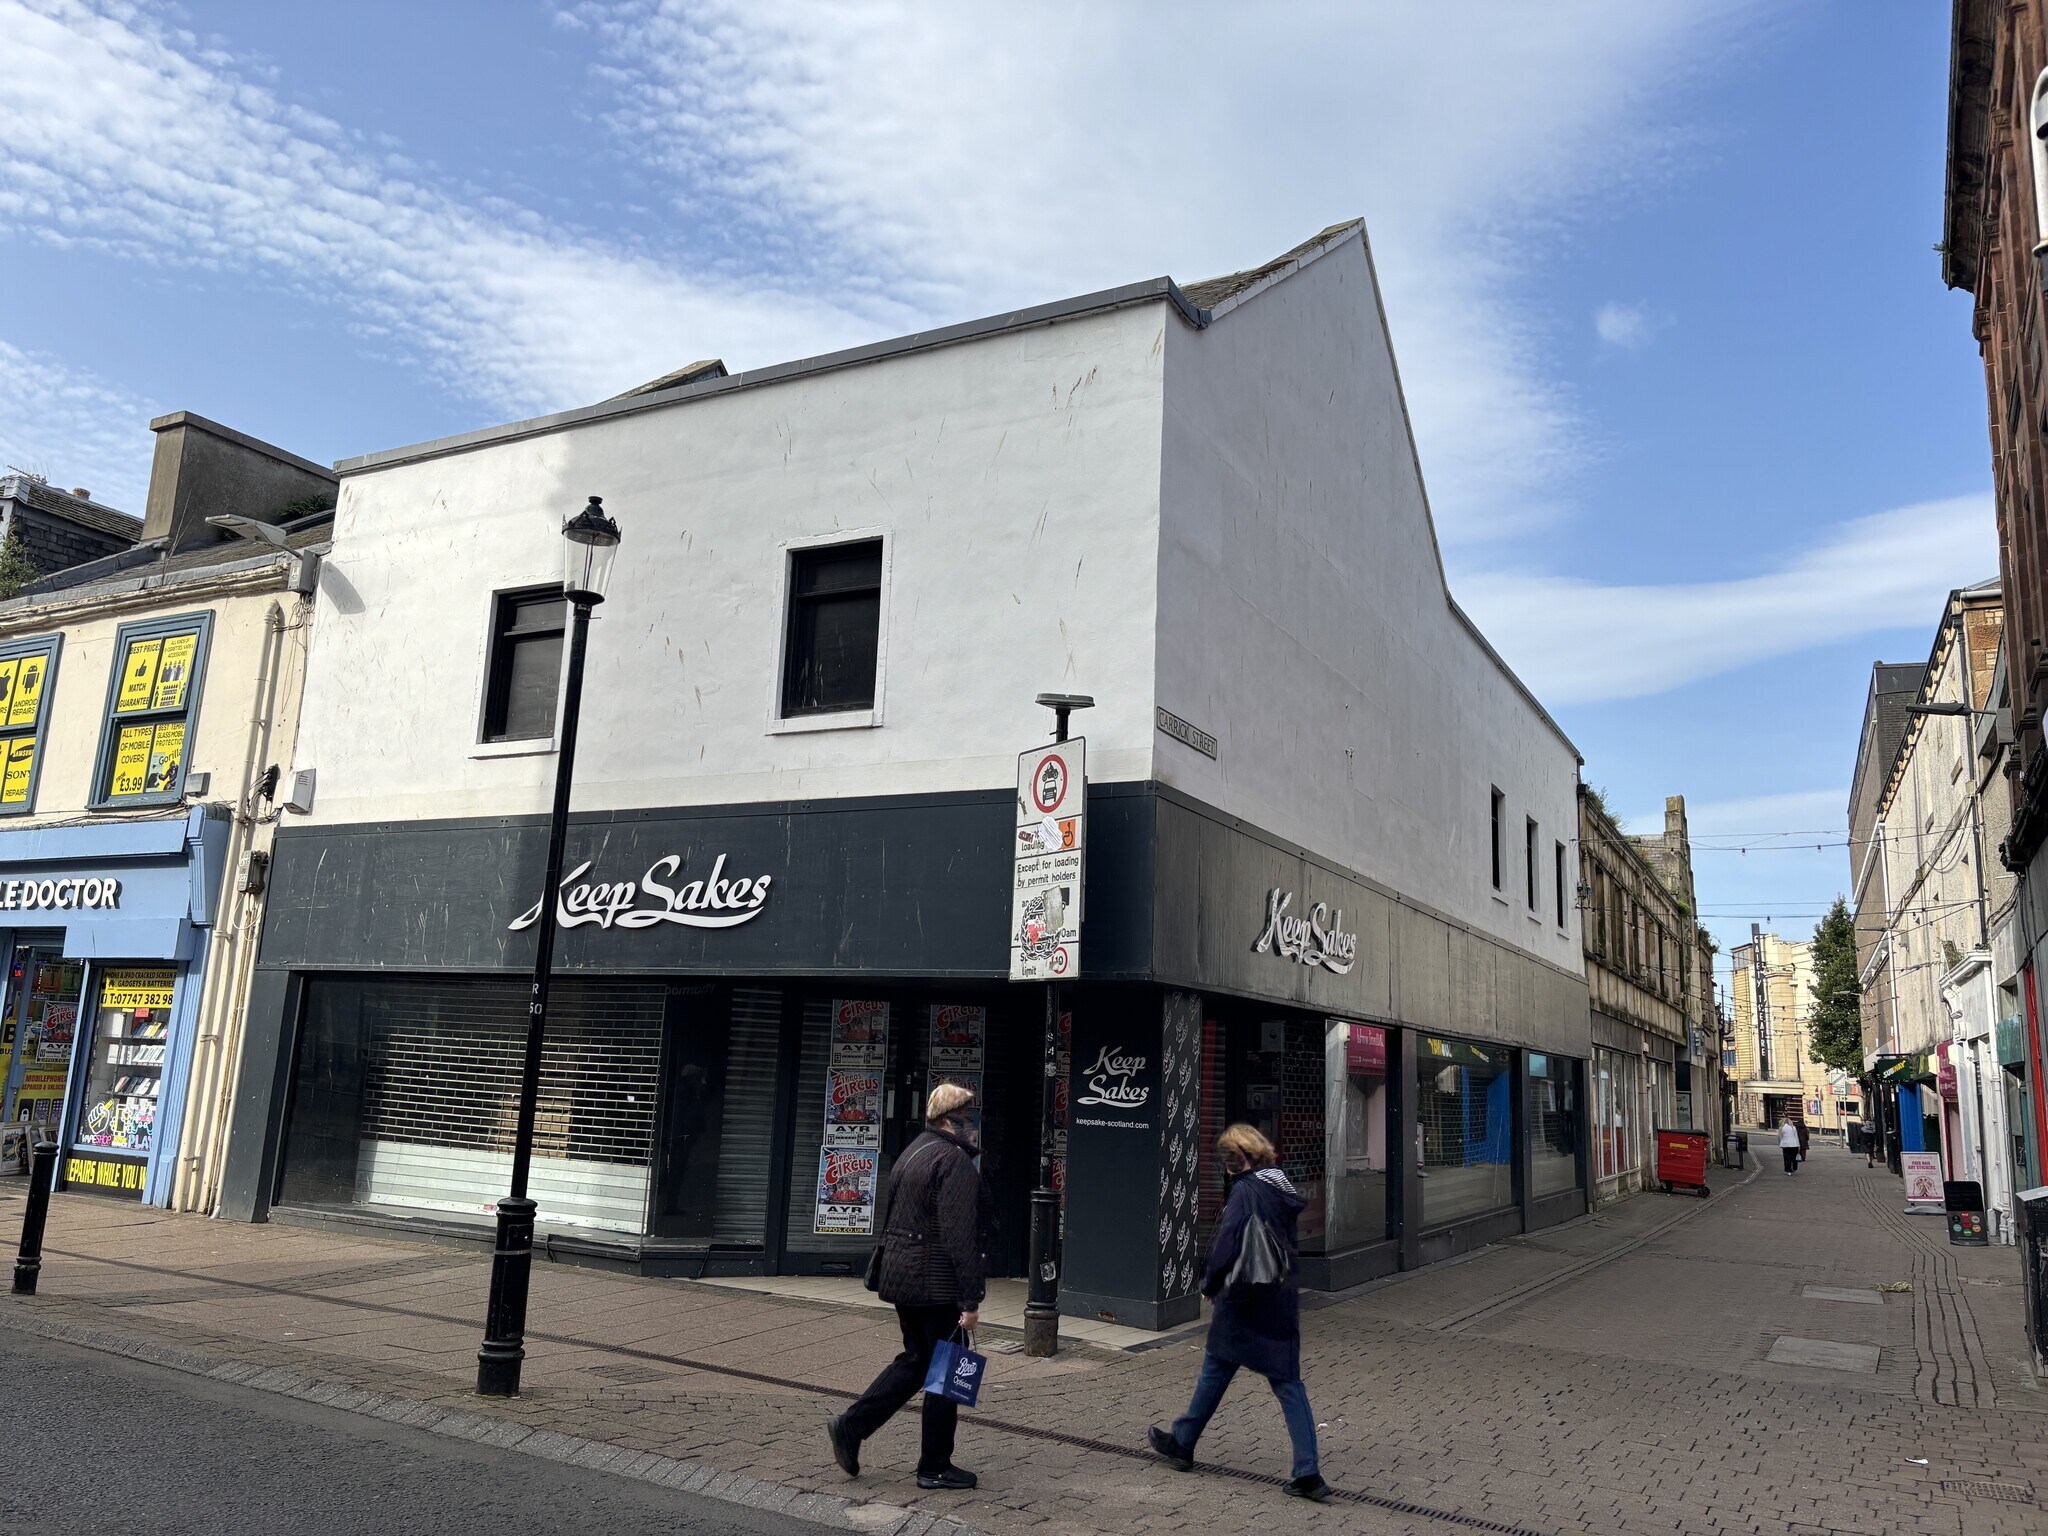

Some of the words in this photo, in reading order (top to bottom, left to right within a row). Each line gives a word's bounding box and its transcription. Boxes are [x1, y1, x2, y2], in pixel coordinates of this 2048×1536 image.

[128, 683, 147, 692] MATCH
[12, 706, 36, 715] REPAIRS
[14, 699, 38, 708] ANDROID
[122, 730, 132, 738] ALL
[134, 727, 152, 737] TYPES
[1158, 712, 1190, 741] CARRICK
[1192, 730, 1216, 754] STREET
[120, 743, 128, 751] OF
[128, 740, 150, 750] MOBILE
[121, 754, 144, 764] COVERS
[120, 777, 142, 792] £3.99
[1017, 862, 1039, 873] Except
[1042, 860, 1052, 870] for
[1054, 856, 1079, 868] loading
[1017, 877, 1026, 888] by
[1028, 874, 1049, 886] permit
[1052, 871, 1076, 882] holders
[21, 878, 119, 909] DOCTOR
[507, 860, 637, 930] Keep
[614, 853, 773, 929] Sakes
[1257, 887, 1311, 964] Keep
[1303, 902, 1358, 975] Sakes
[1753, 935, 1763, 988] GAIETY
[1022, 966, 1036, 977] limit
[110, 994, 144, 1004] T:07747
[144, 994, 160, 1004] 382
[162, 994, 174, 1004] 98
[838, 1000, 884, 1024] CIRCUS
[1082, 1045, 1147, 1077] Keep
[1883, 1060, 1906, 1078] SUBWAY
[832, 1079, 879, 1104] CIRCUS
[1077, 1074, 1150, 1108] Sakes
[1076, 1117, 1150, 1130] keepsake-scotland.com
[824, 1153, 856, 1168] ZIPPOS
[65, 1158, 96, 1184] REPAIRS
[96, 1162, 121, 1187] WHILE
[121, 1164, 140, 1189] YOU
[825, 1159, 873, 1185] CIRCUS
[953, 1376, 972, 1390] Opticians
